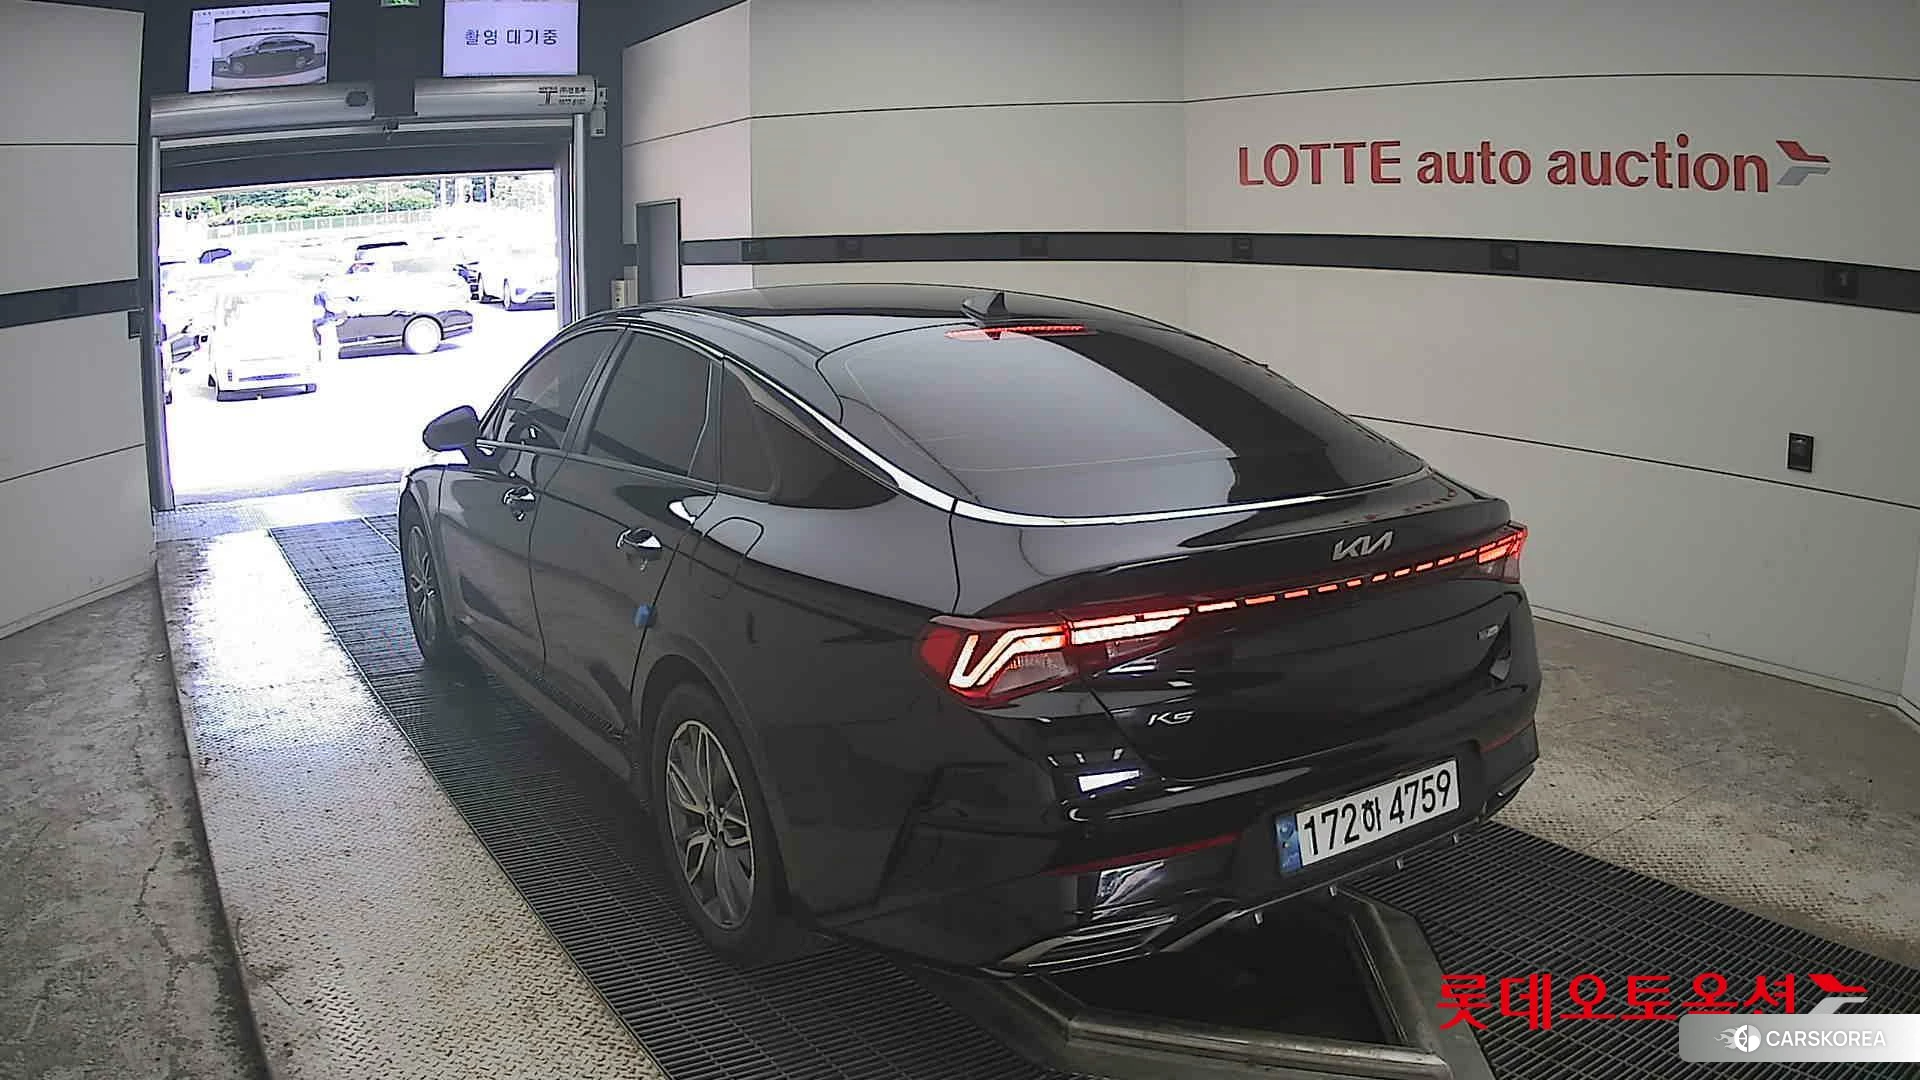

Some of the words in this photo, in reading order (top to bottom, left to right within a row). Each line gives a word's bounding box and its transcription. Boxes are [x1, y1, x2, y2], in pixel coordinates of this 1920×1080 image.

[1239, 140, 1401, 186] LOTTE
[1416, 140, 1532, 185] auto
[1547, 133, 1770, 193] auction
[1332, 530, 1395, 562] KIA
[1147, 710, 1194, 727] K5
[1304, 797, 1382, 856] 172하
[1389, 769, 1452, 825] 4759
